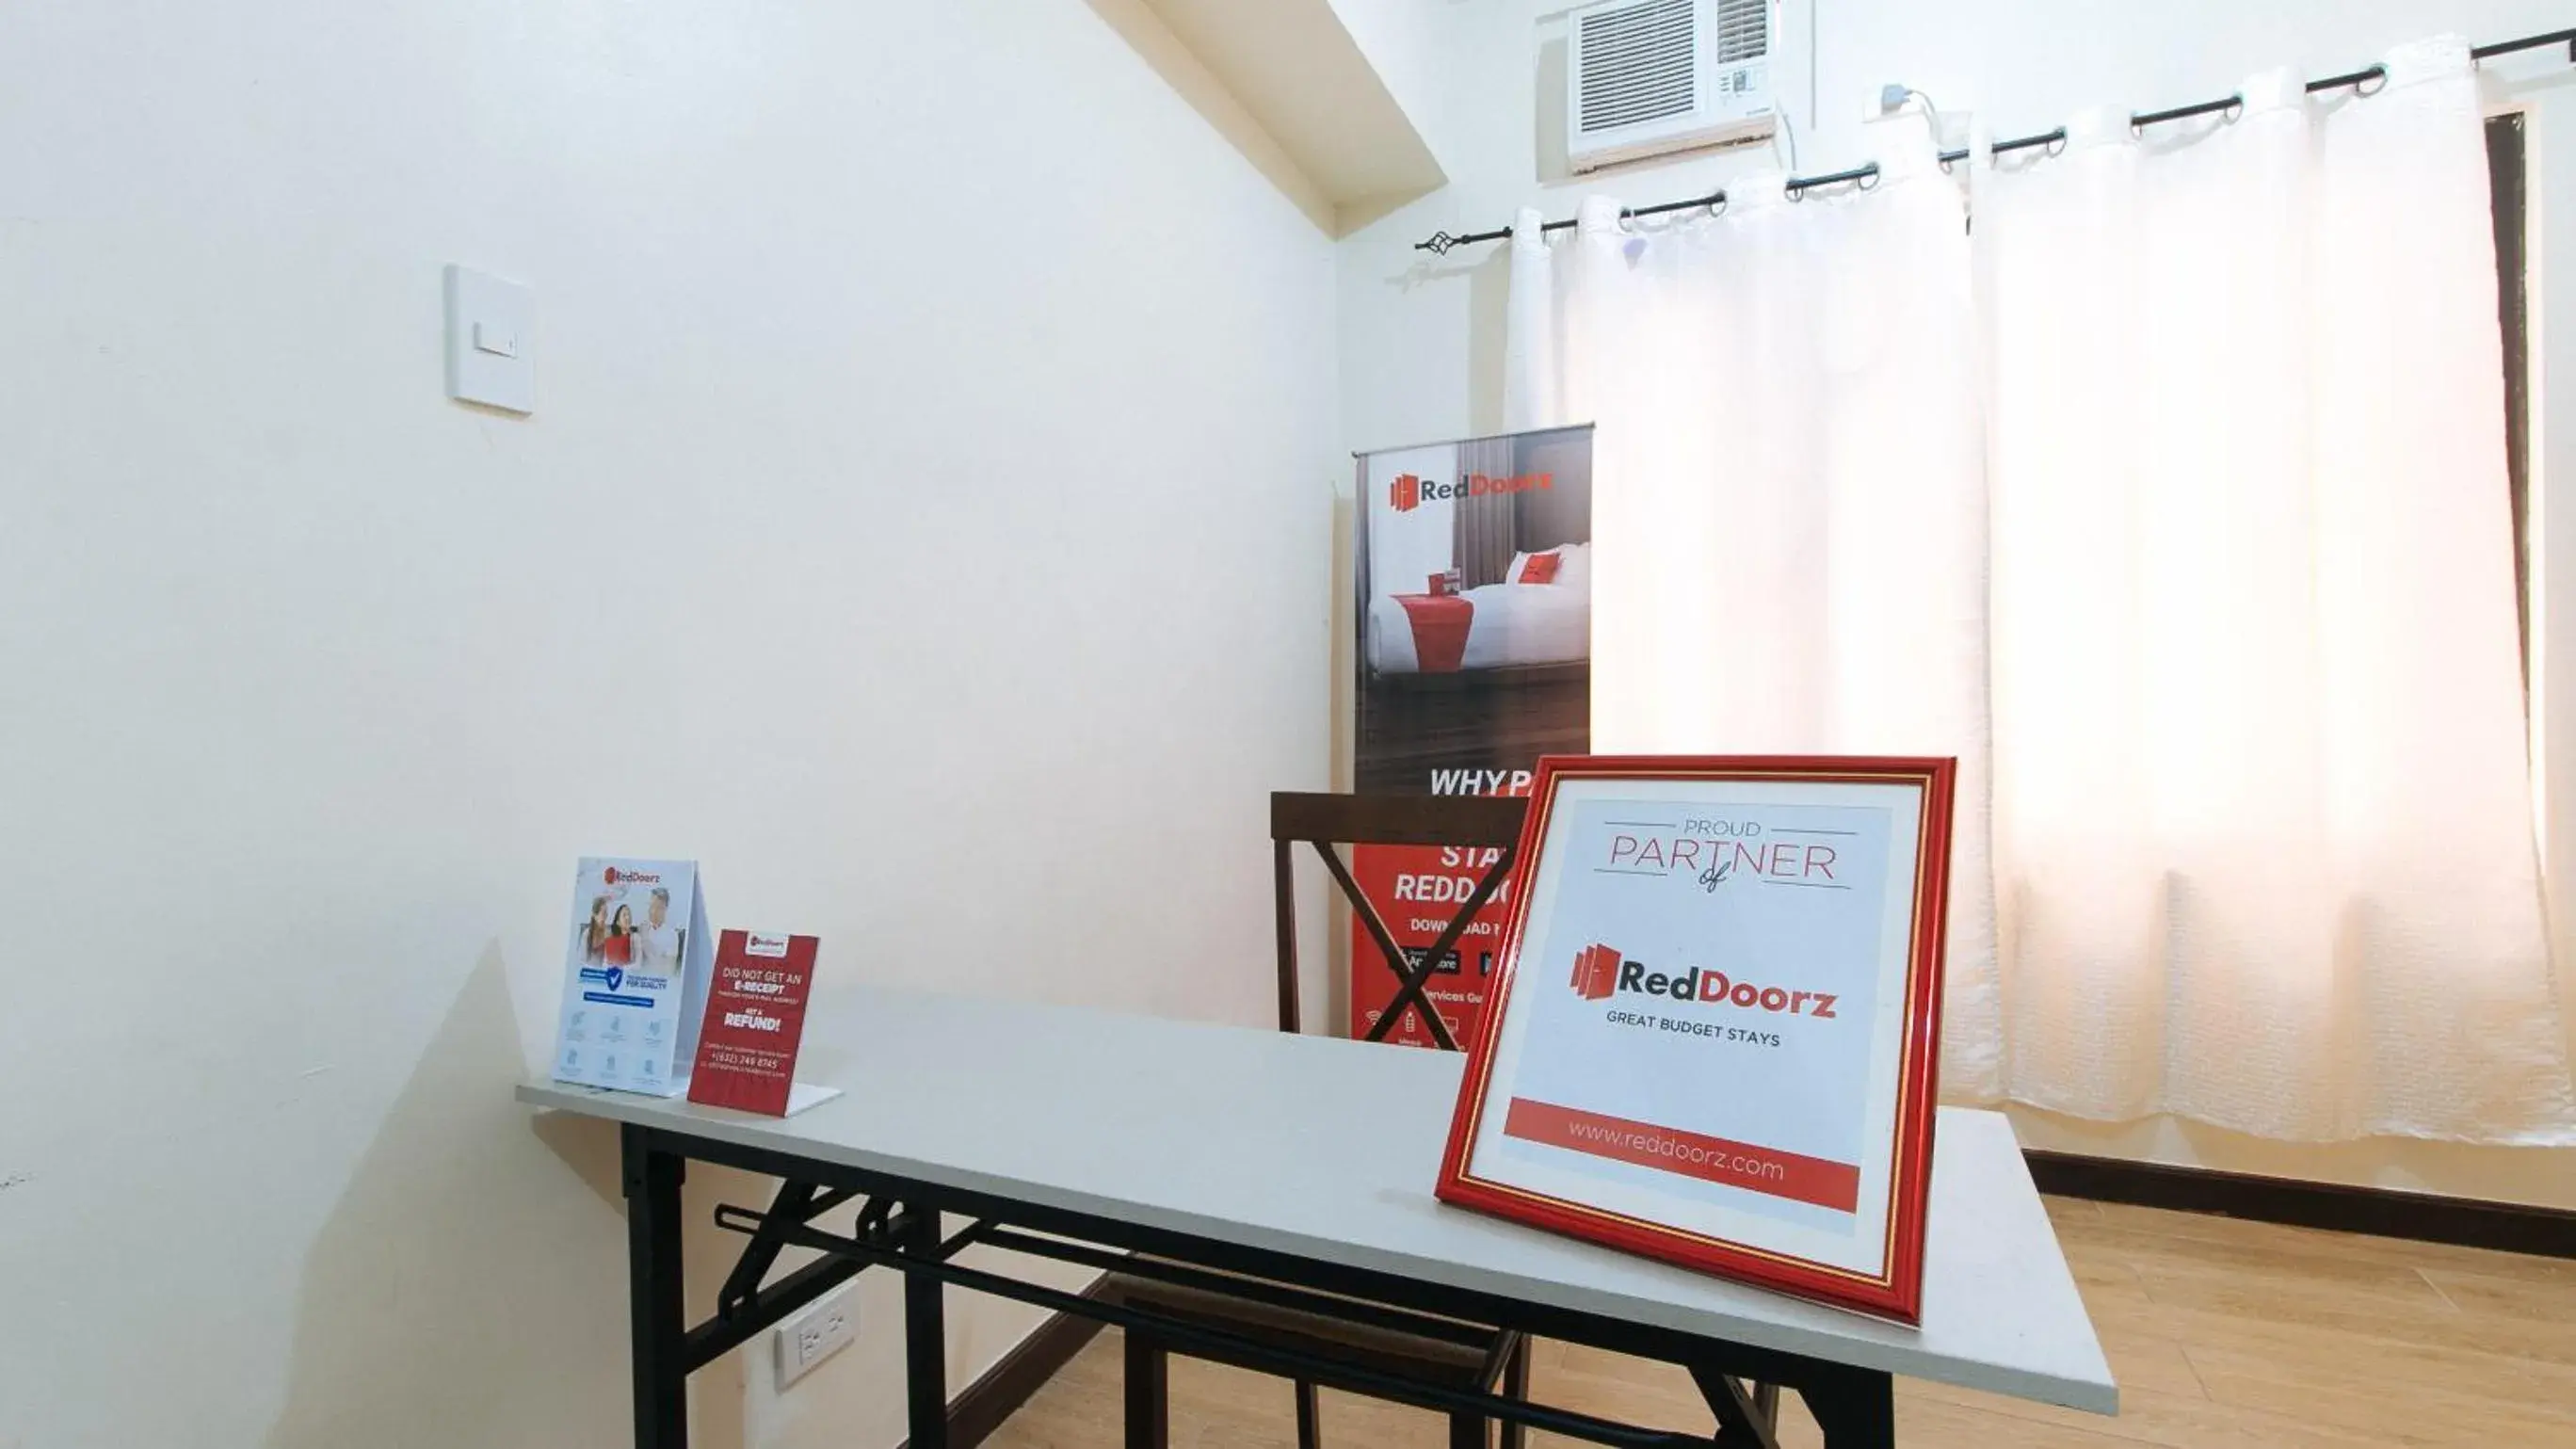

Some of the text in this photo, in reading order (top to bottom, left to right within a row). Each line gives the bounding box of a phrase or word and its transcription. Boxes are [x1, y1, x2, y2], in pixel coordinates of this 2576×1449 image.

[1421, 473, 1552, 501] RedDoorz
[1431, 768, 1506, 796] WHY
[1683, 819, 1762, 837] PROUD
[1441, 846, 1506, 868] STA
[1610, 835, 1837, 879] PARTNER
[1699, 861, 1731, 894] of
[722, 967, 802, 985] DID NOT GET AN
[1618, 960, 1838, 1019] RedDoorz
[1427, 989, 1465, 1002] ervices
[724, 1012, 781, 1032] REFUND!
[1606, 1010, 1780, 1047] GREAT BUDGET STAYS
[1569, 1120, 1784, 1181] www.reddoorz.com
